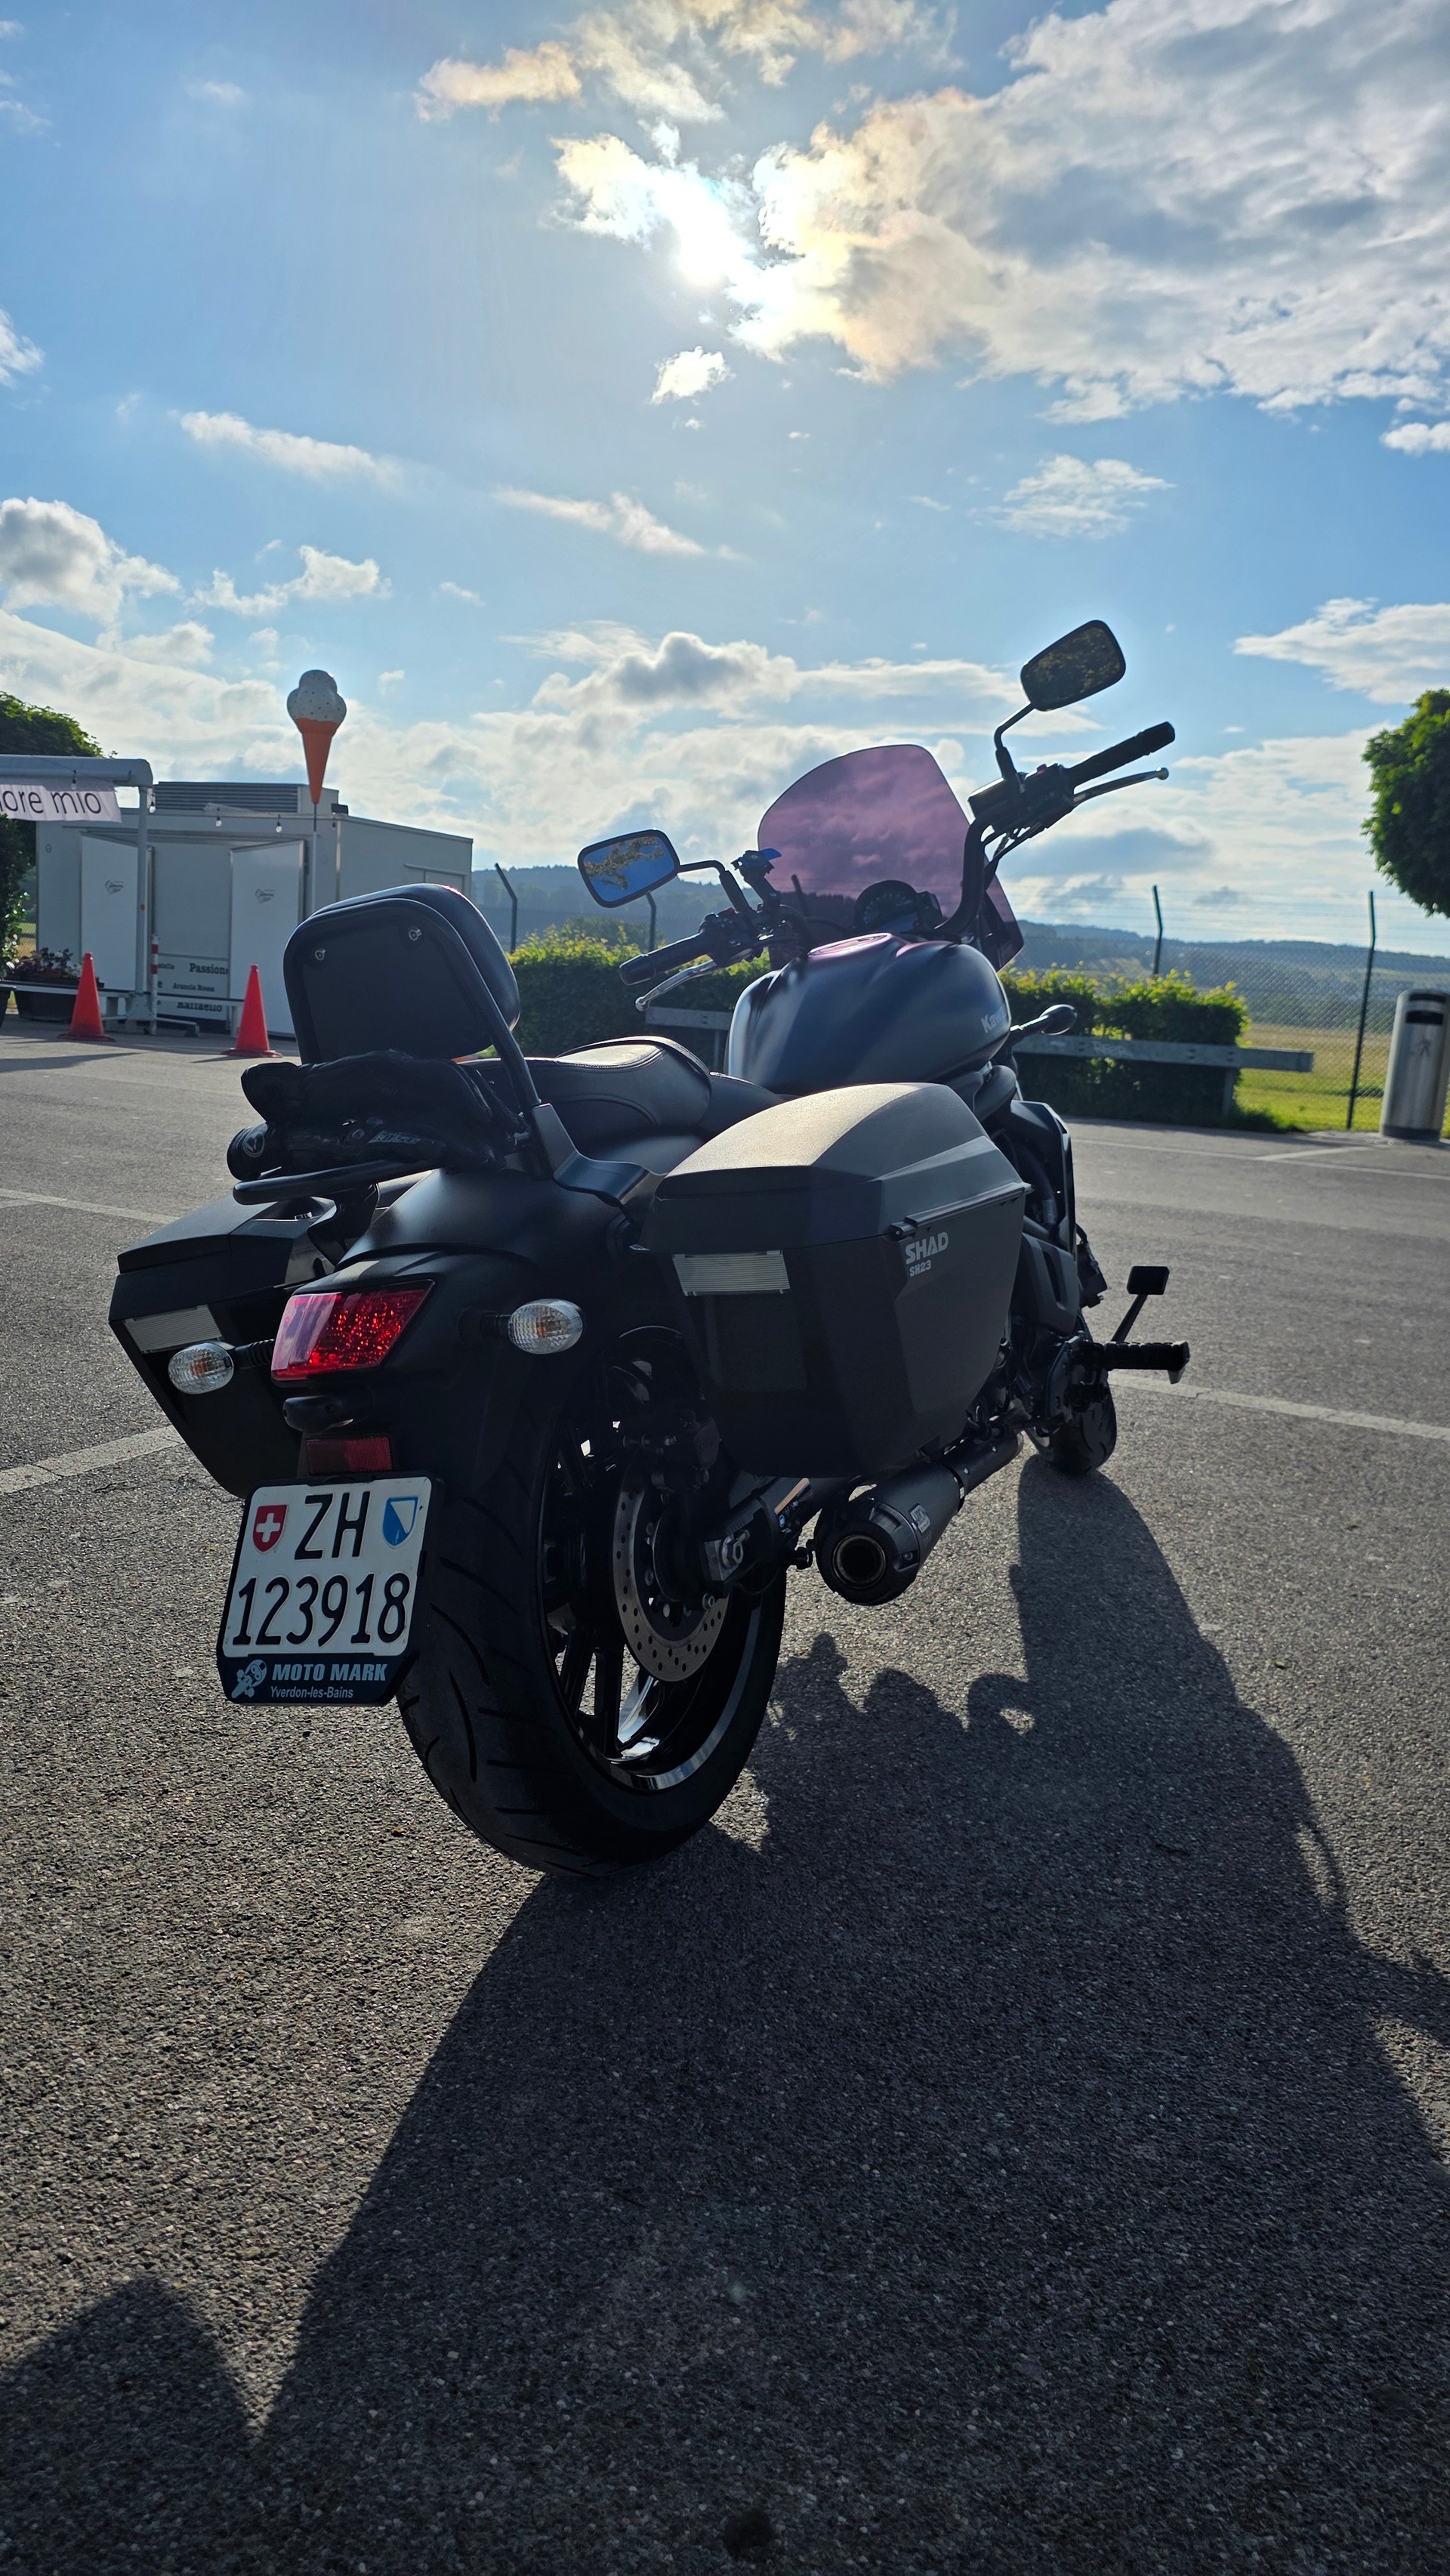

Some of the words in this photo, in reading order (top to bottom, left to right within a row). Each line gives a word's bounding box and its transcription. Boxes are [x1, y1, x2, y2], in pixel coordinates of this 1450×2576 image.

[0, 790, 43, 814] ore
[50, 792, 101, 814] mio
[905, 1232, 949, 1265] SHAD
[909, 1259, 931, 1277] SH23
[294, 1491, 370, 1560] ZH
[232, 1573, 410, 1647] 123918
[272, 1664, 324, 1681] MOTO
[330, 1663, 387, 1681] MARK
[271, 1685, 353, 1698] Yverdon-les-Bains
